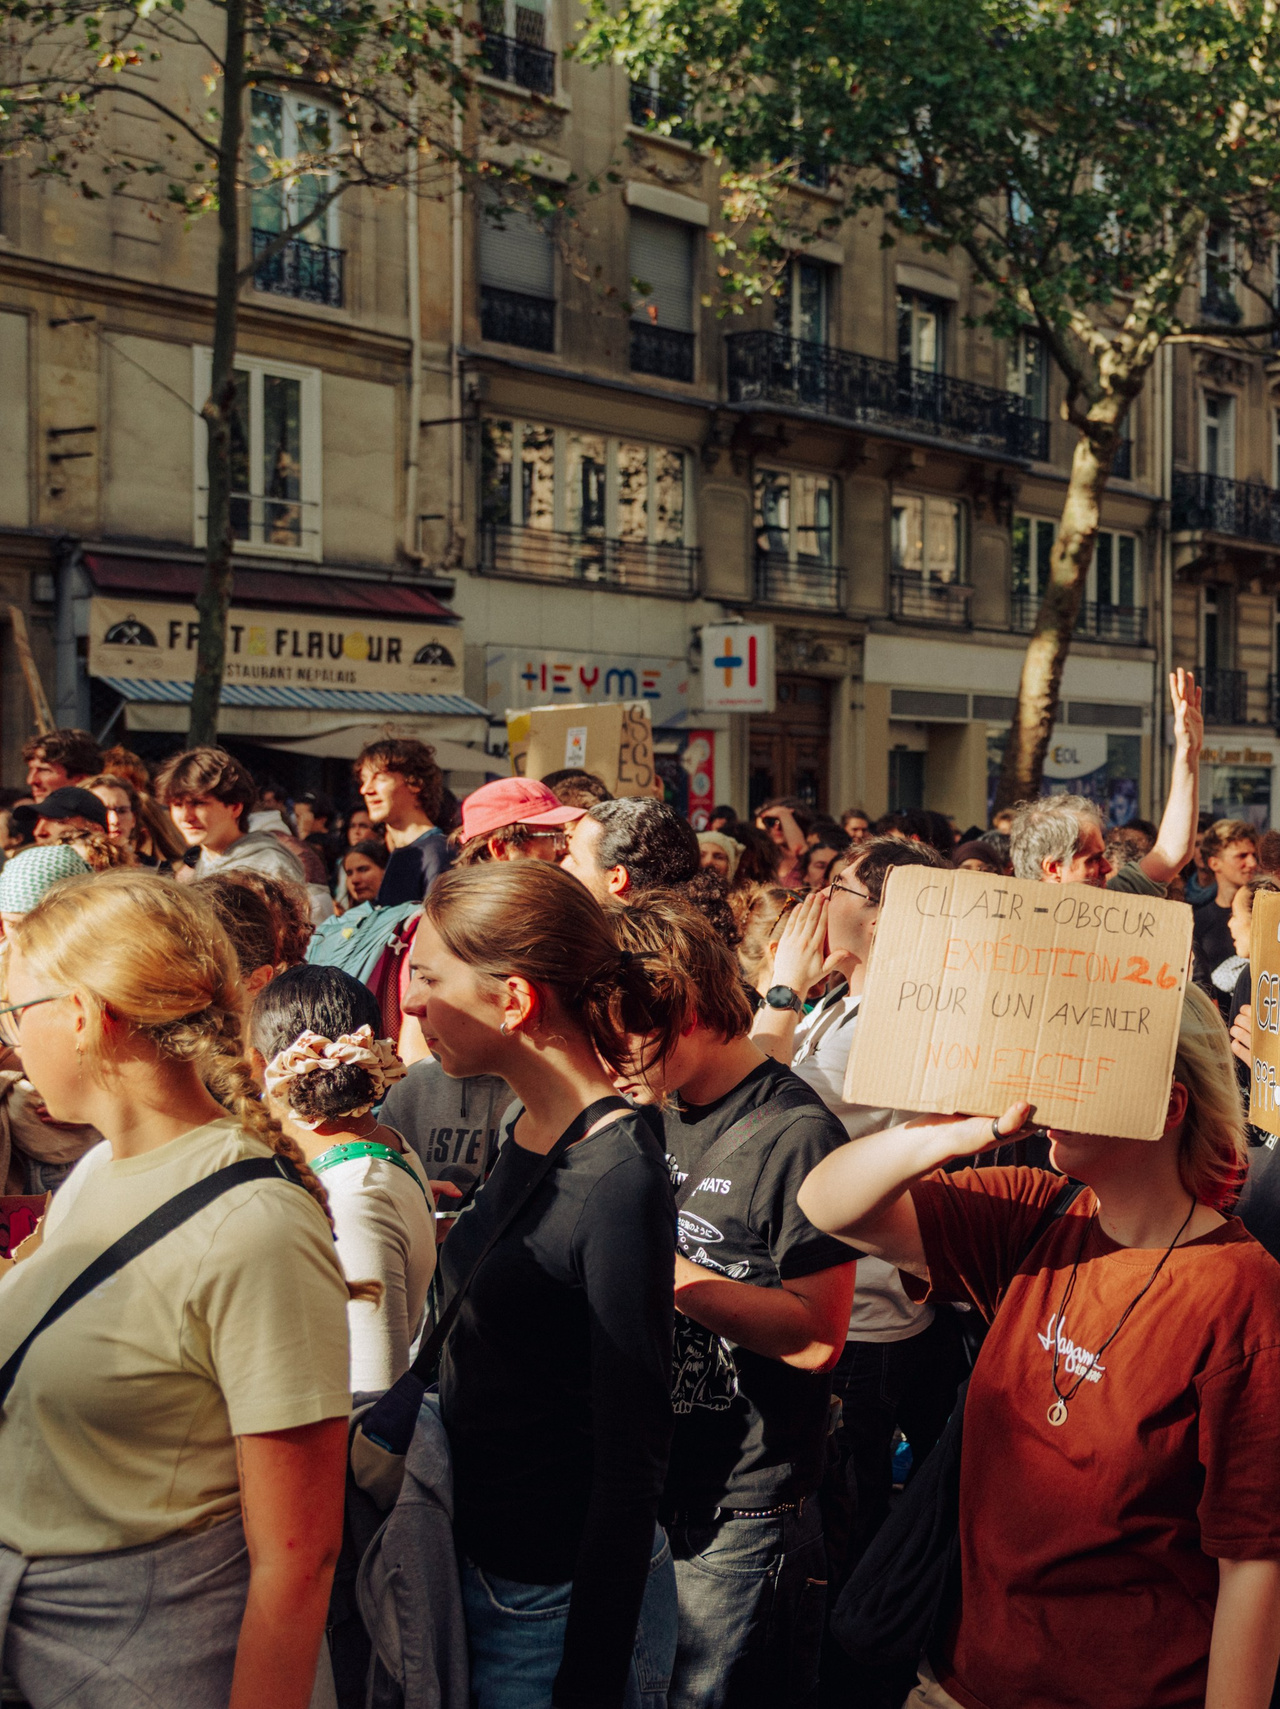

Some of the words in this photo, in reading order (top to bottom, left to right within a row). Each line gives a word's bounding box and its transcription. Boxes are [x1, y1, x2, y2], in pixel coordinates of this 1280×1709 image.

[225, 662, 293, 680] STAURANT
[521, 662, 662, 699] HEYME
[942, 933, 1120, 984] EXPÉDITION
[897, 980, 968, 1015] POUR
[991, 993, 1035, 1019] UN
[1047, 1002, 1151, 1035] AVENIR
[924, 1041, 981, 1071] NON
[992, 1047, 1117, 1086] FICTIF
[1253, 1054, 1277, 1112] 1997
[698, 1177, 732, 1195] HATS
